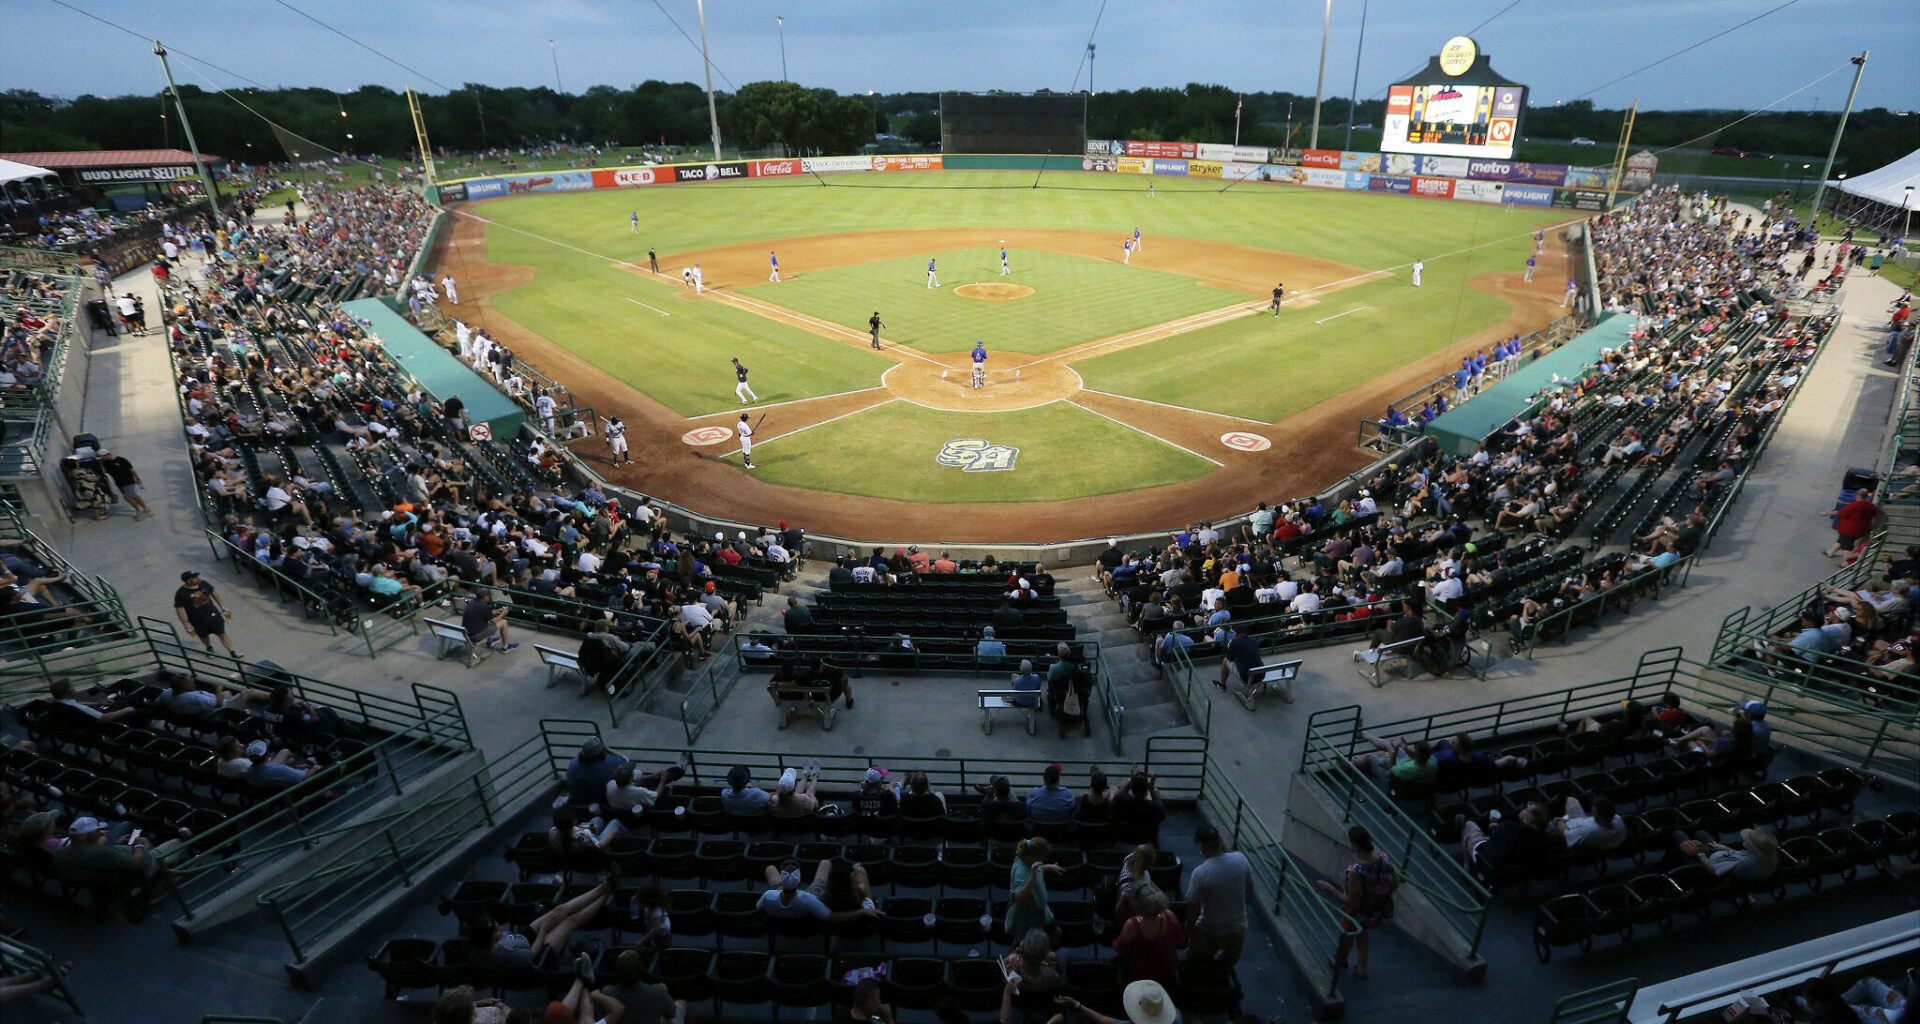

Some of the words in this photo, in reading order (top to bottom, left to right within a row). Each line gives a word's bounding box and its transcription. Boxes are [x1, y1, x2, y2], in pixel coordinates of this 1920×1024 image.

[1304, 154, 1321, 162] Great
[1323, 156, 1338, 164] Clips
[82, 170, 112, 180] BUD
[112, 169, 151, 179] LIGHT
[151, 166, 194, 180] SELTZER
[680, 169, 704, 179] TACO
[720, 166, 741, 176] BELL
[1189, 164, 1223, 174] stryker
[1470, 162, 1510, 175] metro
[1504, 189, 1523, 198] BUD
[1523, 191, 1550, 200] LIGHT
